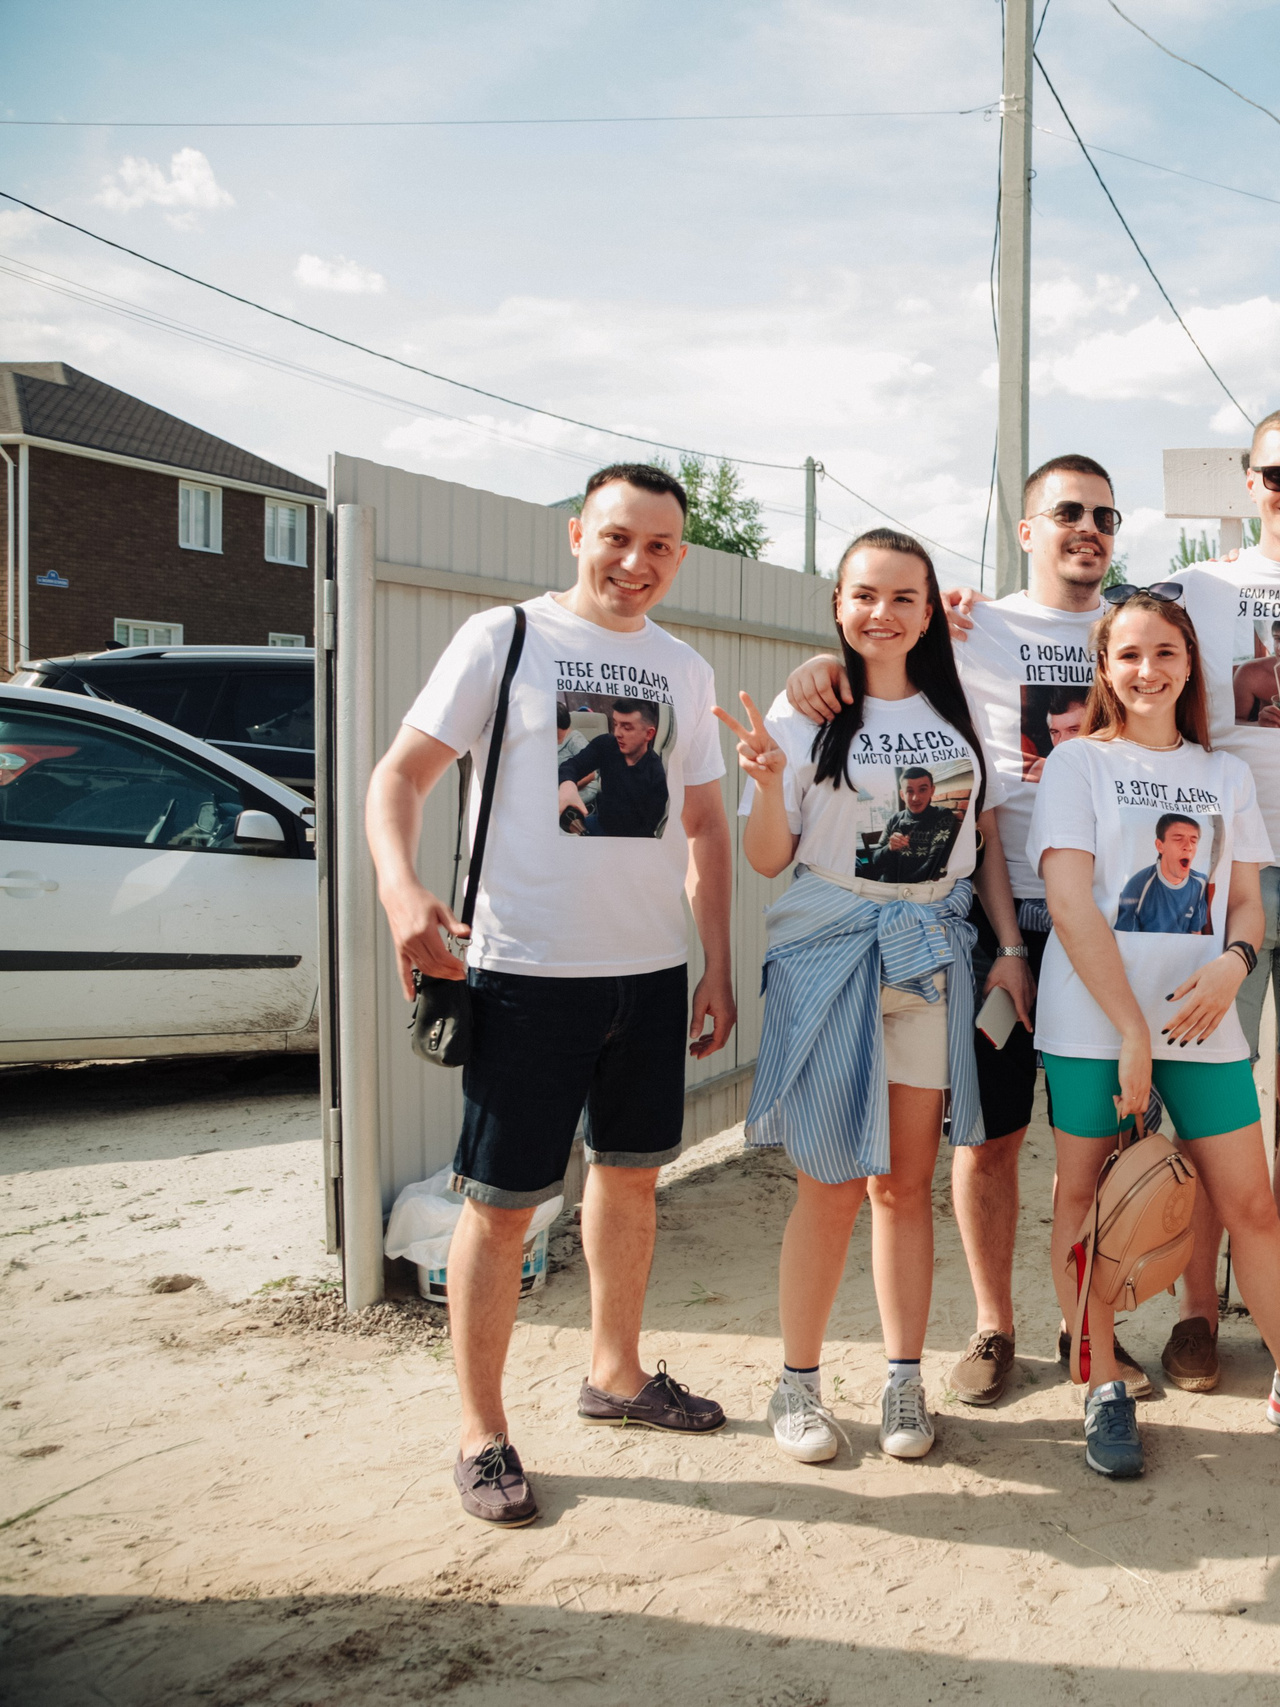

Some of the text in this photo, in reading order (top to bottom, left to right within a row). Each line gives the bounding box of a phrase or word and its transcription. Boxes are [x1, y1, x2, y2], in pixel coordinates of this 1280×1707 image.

[1239, 587, 1265, 599] ЕСЛИ
[1237, 601, 1247, 617] Я
[1020, 644, 1031, 661] С
[555, 660, 669, 692] ТЕБЕ СЕГОДНЯ
[1026, 664, 1094, 683] ПЕТУША
[557, 678, 602, 693] ВОДКА
[606, 682, 620, 695] НЕ
[624, 684, 638, 697] ВО
[859, 731, 954, 753] Я ЗДЕСЬ
[853, 747, 971, 766] ЧИСТО РАДИ БУХЛА!
[1114, 780, 1218, 803] В ЭТОТ ДЕНЬ
[1117, 795, 1158, 807] РОДИЛИ
[1159, 801, 1180, 812] ТЕБЯ
[1182, 804, 1193, 813] НА
